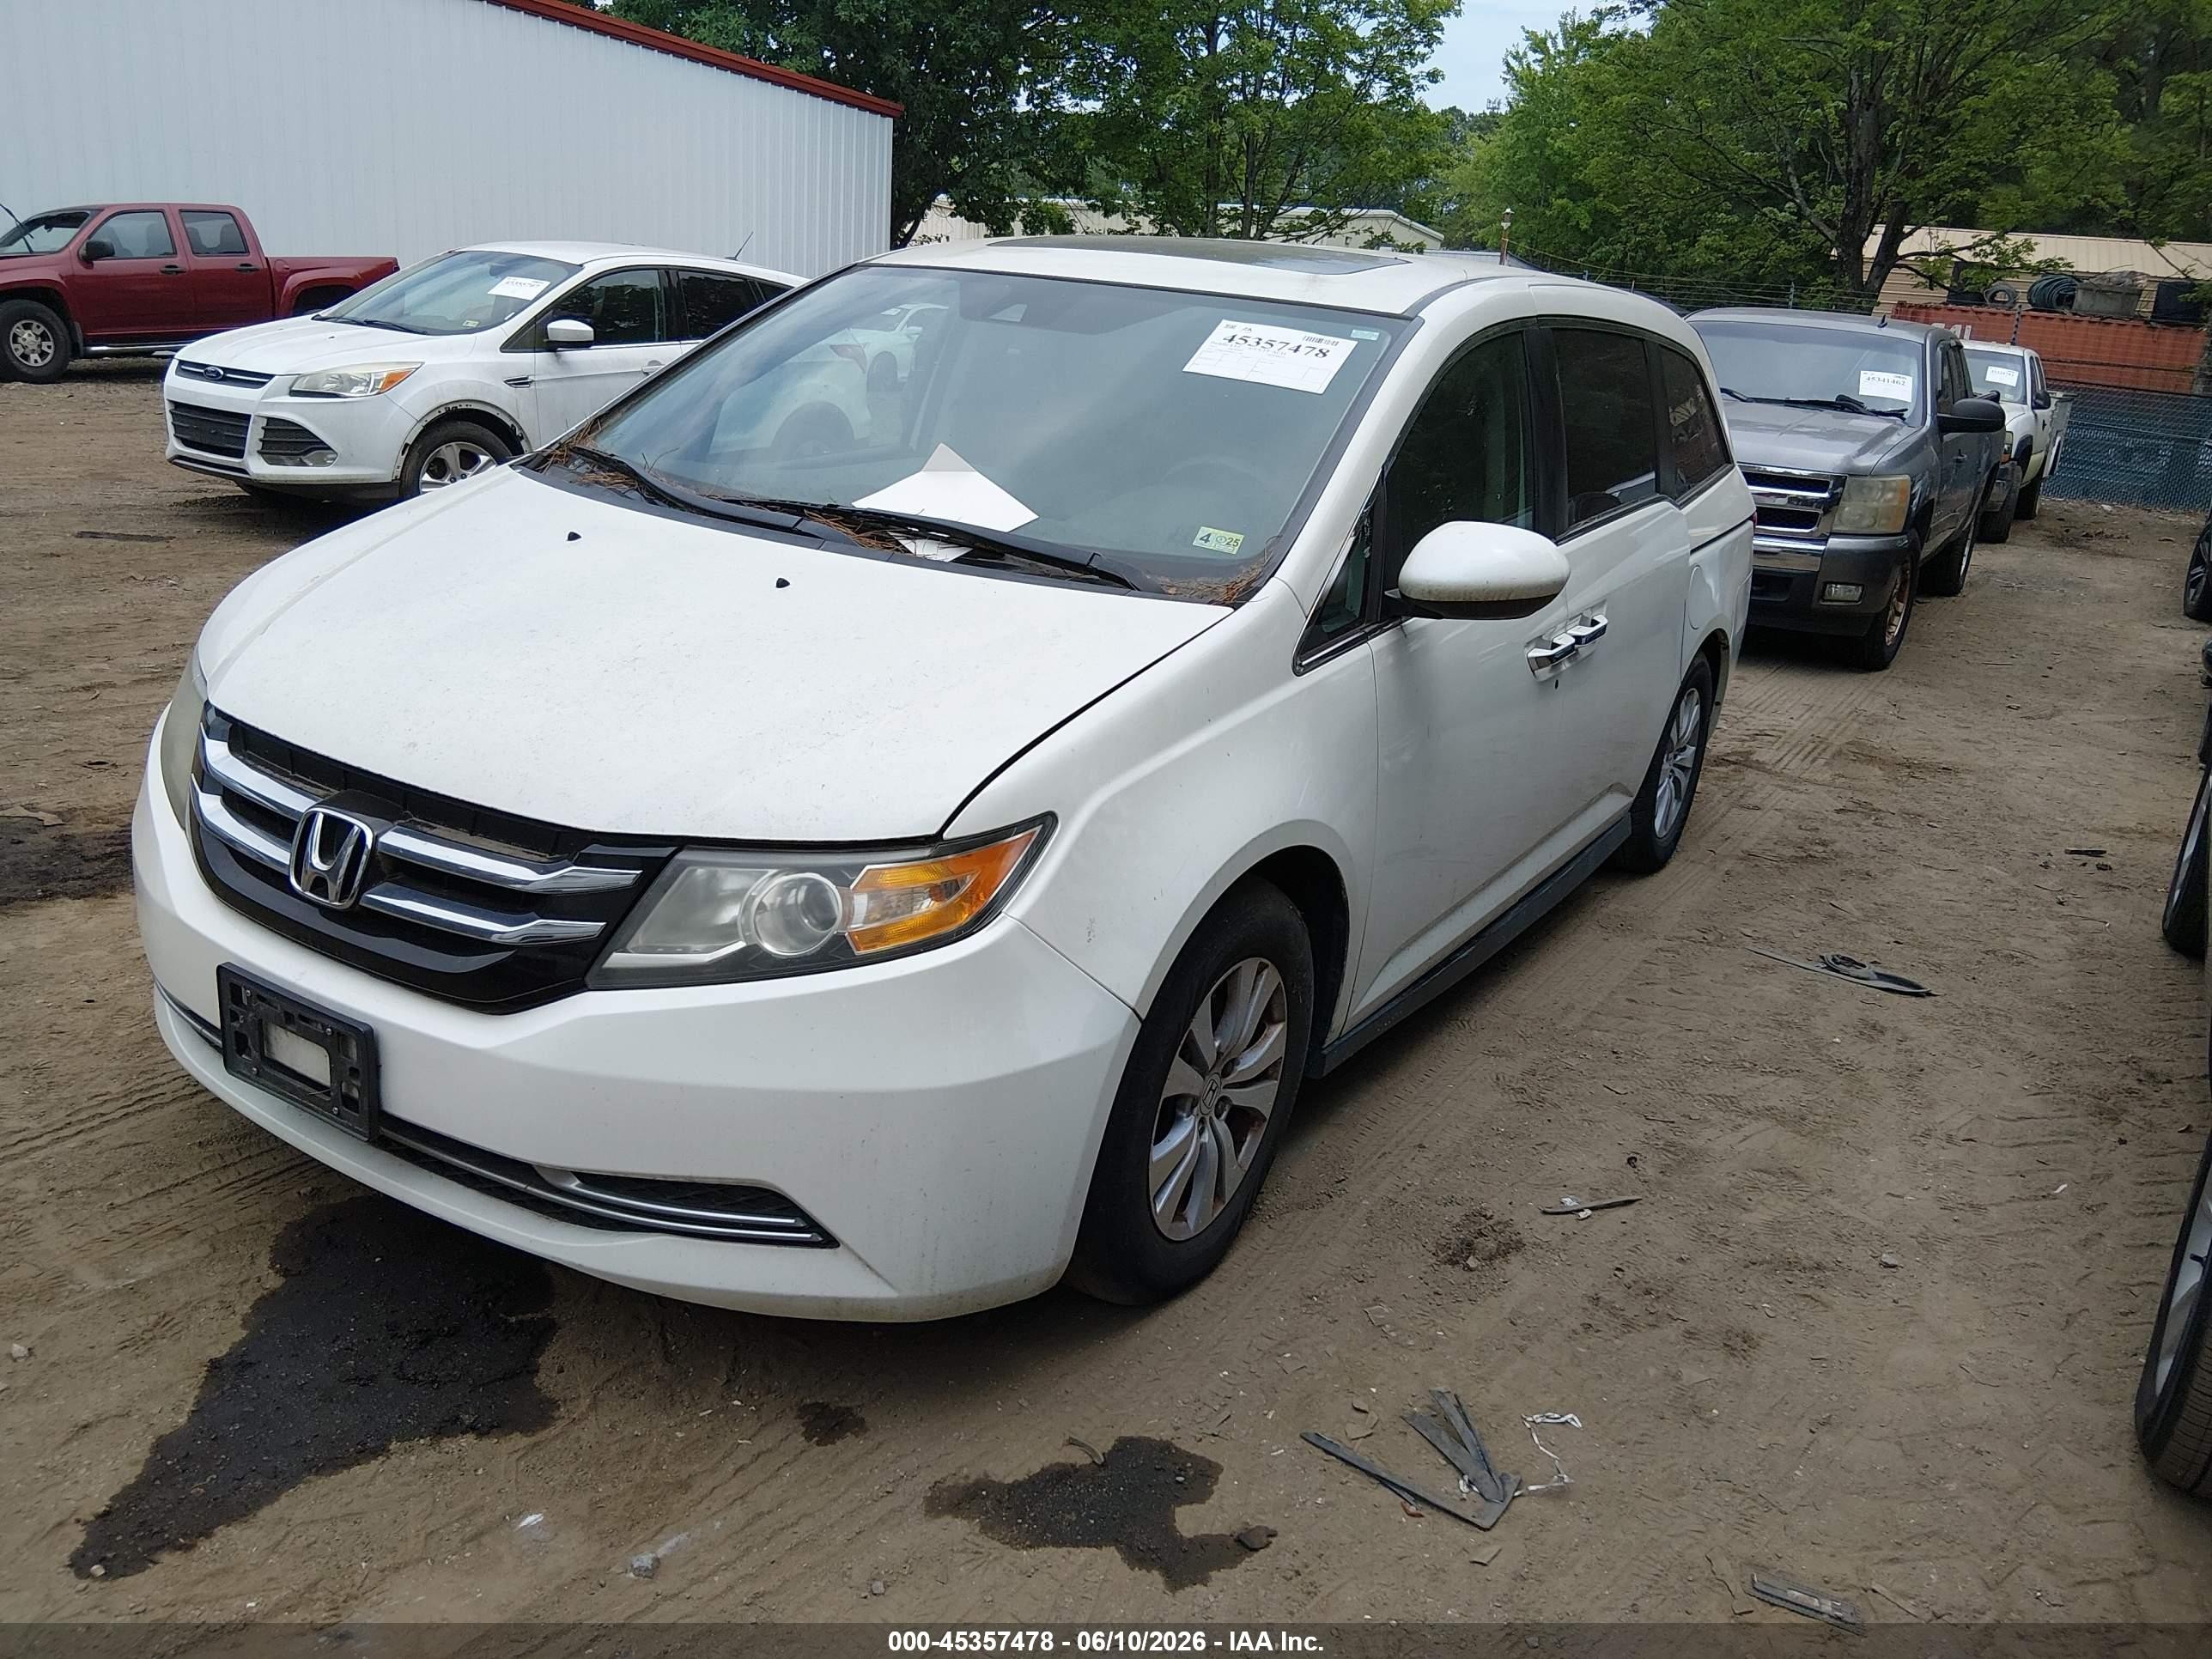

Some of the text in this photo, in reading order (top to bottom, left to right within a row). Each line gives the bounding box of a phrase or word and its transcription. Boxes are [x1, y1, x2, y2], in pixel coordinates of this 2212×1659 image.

[1223, 333, 1330, 359] 45357478
[1199, 532, 1241, 547] 4 25
